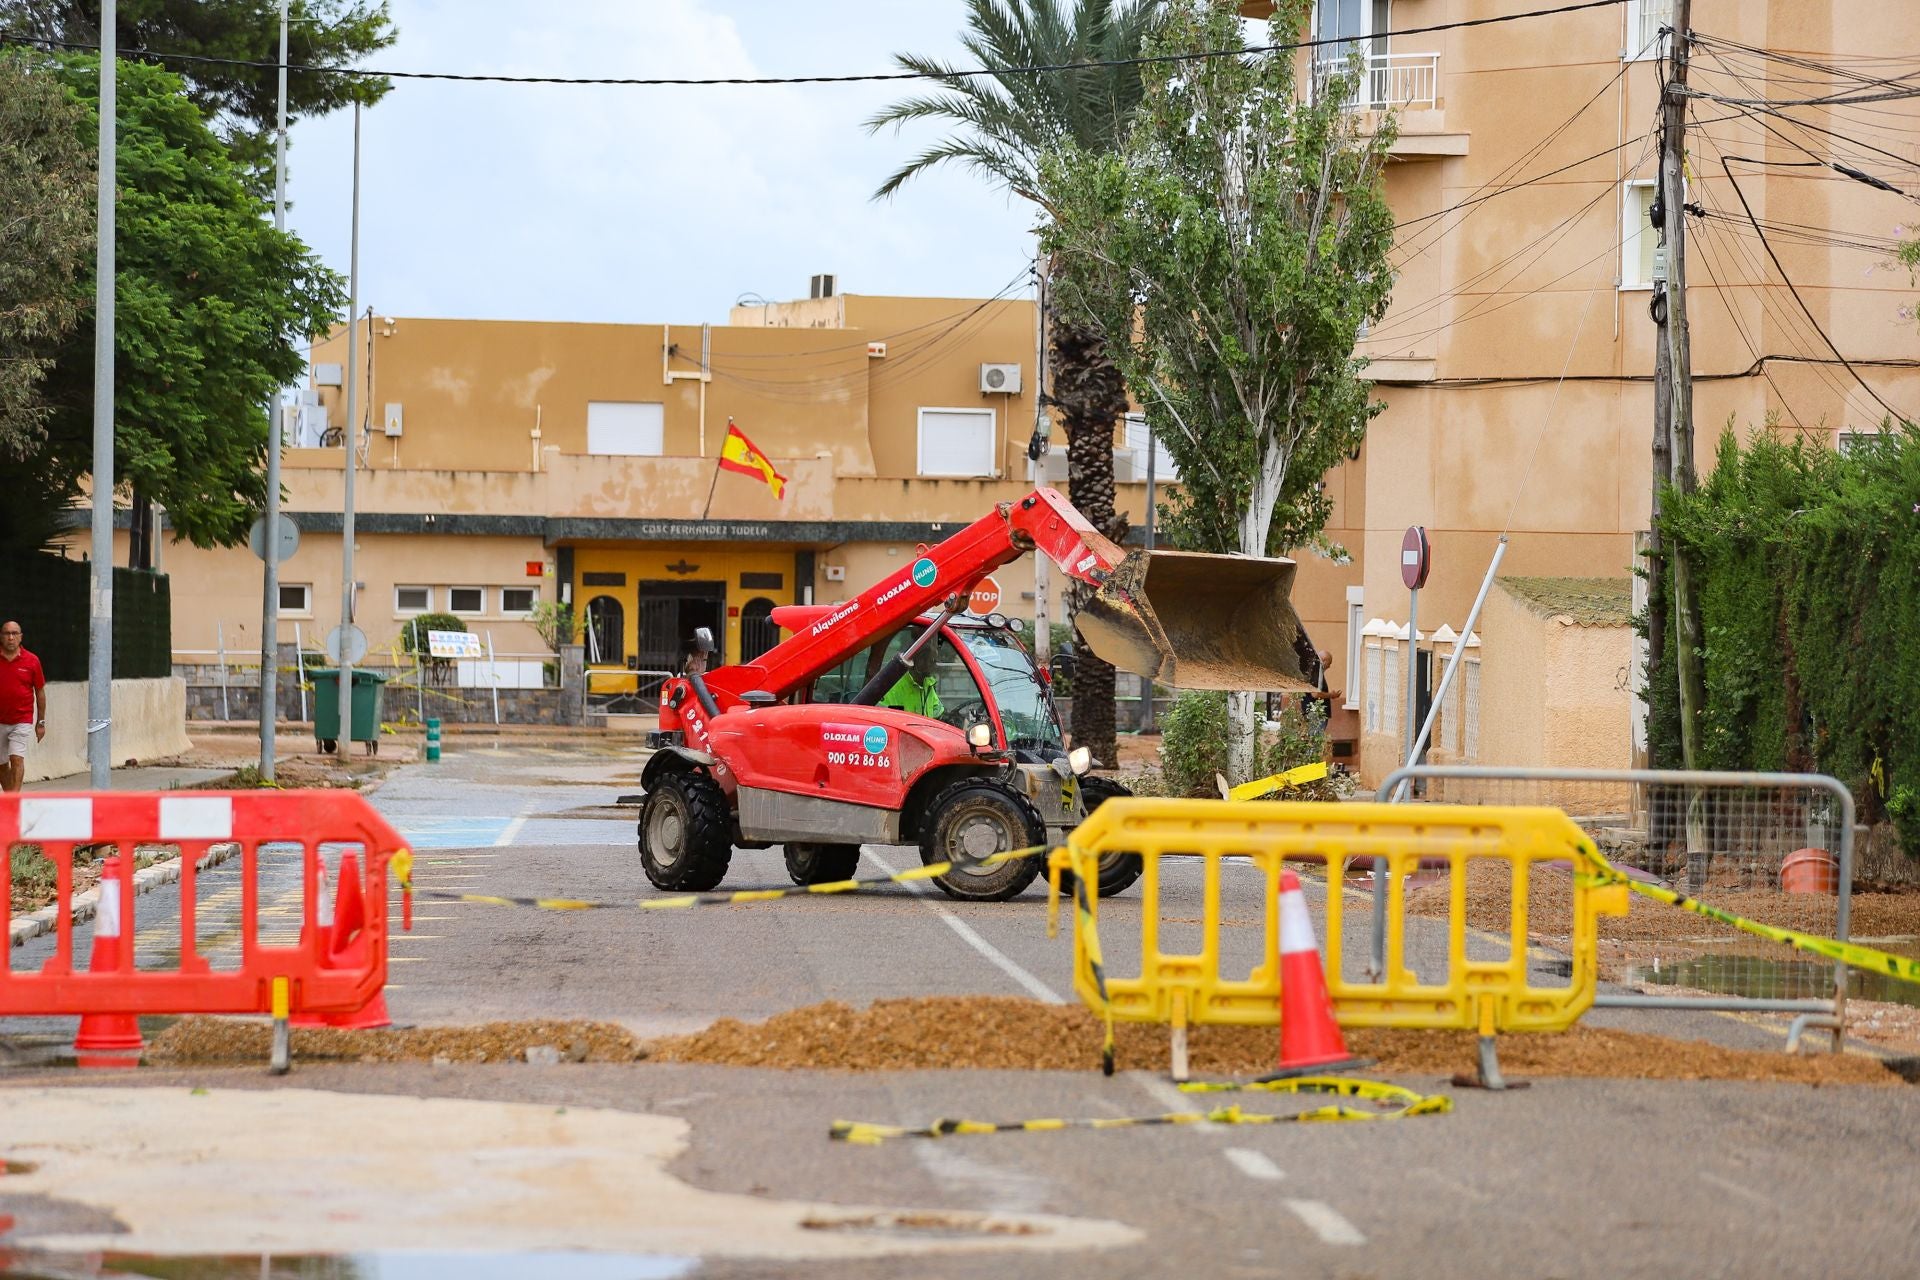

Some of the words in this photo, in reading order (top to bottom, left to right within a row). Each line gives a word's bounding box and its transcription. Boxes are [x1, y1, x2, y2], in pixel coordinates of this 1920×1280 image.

[731, 525, 768, 536] TUDELA
[915, 564, 935, 581] HUNE
[865, 735, 886, 744] HUNE
[828, 752, 845, 764] 900
[848, 753, 859, 765] 92
[862, 754, 874, 766] 86
[877, 755, 890, 768] 86
